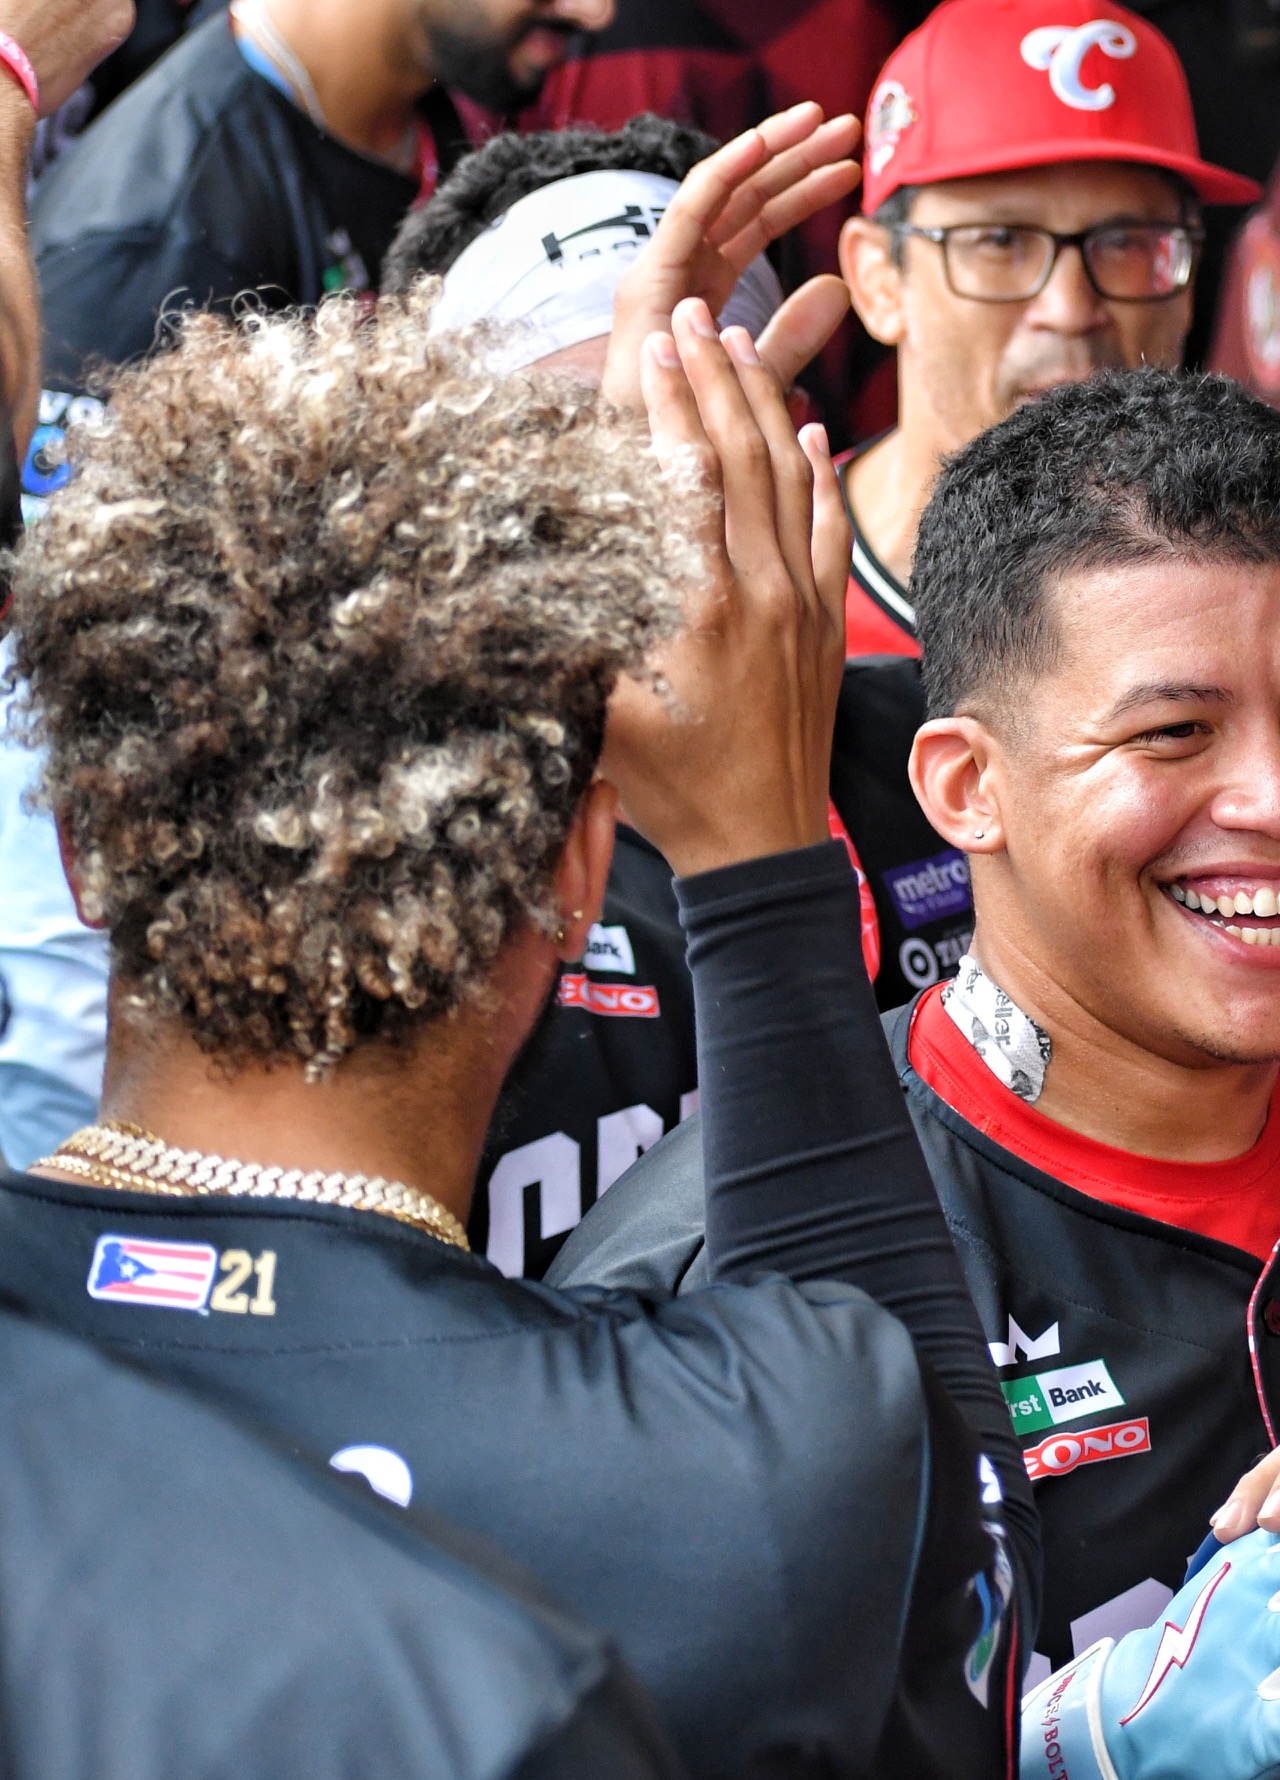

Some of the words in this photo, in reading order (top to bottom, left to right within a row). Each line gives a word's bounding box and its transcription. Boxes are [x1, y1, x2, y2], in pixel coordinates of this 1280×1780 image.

[1020, 19, 1137, 110] C
[893, 858, 968, 901] metro
[587, 940, 622, 959] ank
[994, 987, 1013, 1046] eller
[210, 1249, 276, 1315] 21
[1006, 1394, 1042, 1418] rst
[1049, 1380, 1107, 1407] Bank
